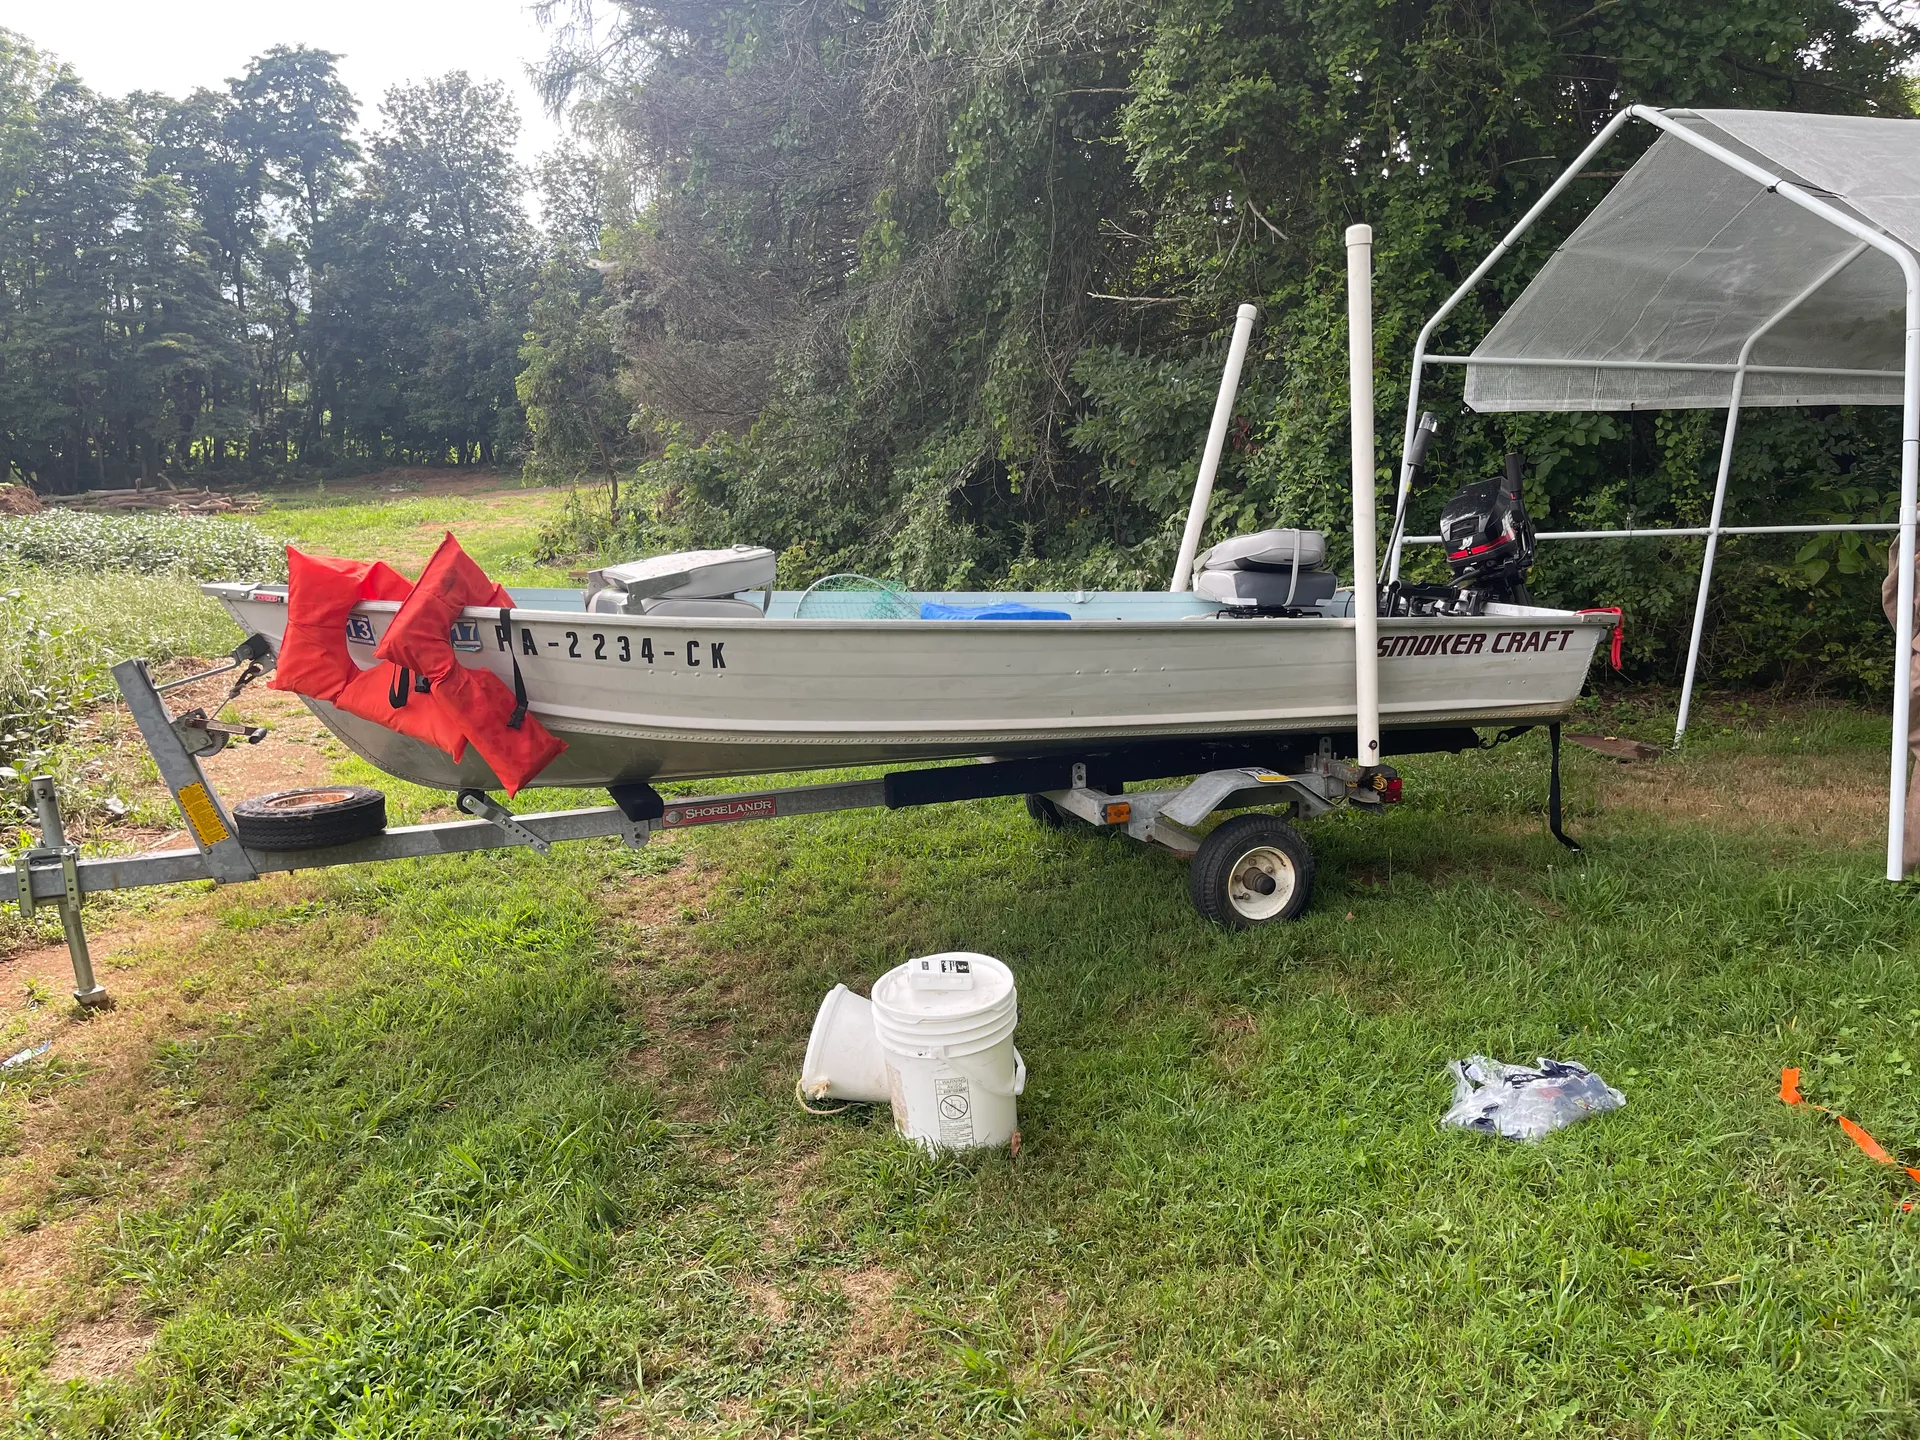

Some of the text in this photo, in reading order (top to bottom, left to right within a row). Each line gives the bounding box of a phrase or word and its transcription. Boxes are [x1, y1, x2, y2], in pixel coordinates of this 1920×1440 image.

[346, 619, 371, 639] 13
[451, 622, 476, 641] 17
[1377, 629, 1575, 658] SMOKER CRAFT
